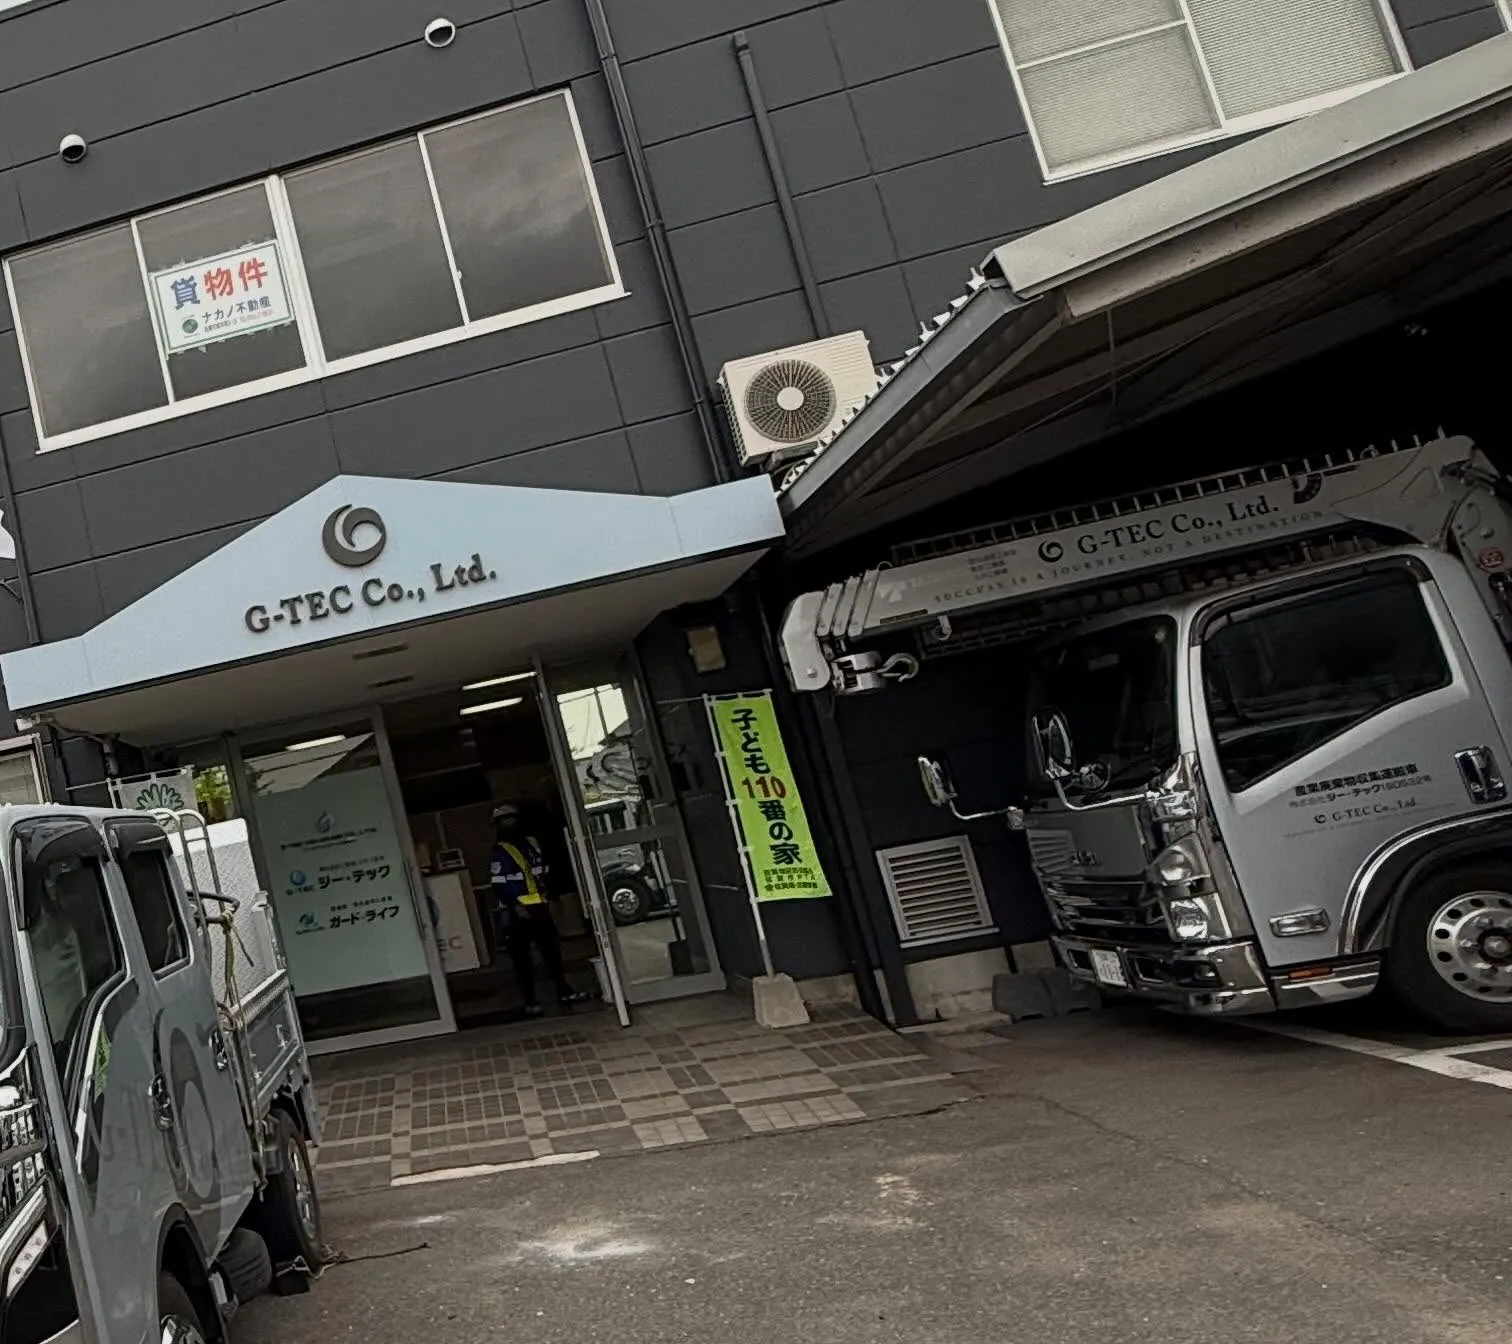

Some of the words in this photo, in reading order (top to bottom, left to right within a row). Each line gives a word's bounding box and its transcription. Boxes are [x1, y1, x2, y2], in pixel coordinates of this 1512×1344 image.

[170, 257, 268, 310] 貸物件
[1077, 519, 1166, 554] G-TEC
[1171, 511, 1223, 537] Co.,
[1227, 495, 1280, 522] Ltd.
[244, 583, 354, 634] G-TEC
[361, 577, 426, 608] Co.,
[429, 552, 497, 592] Ltd.
